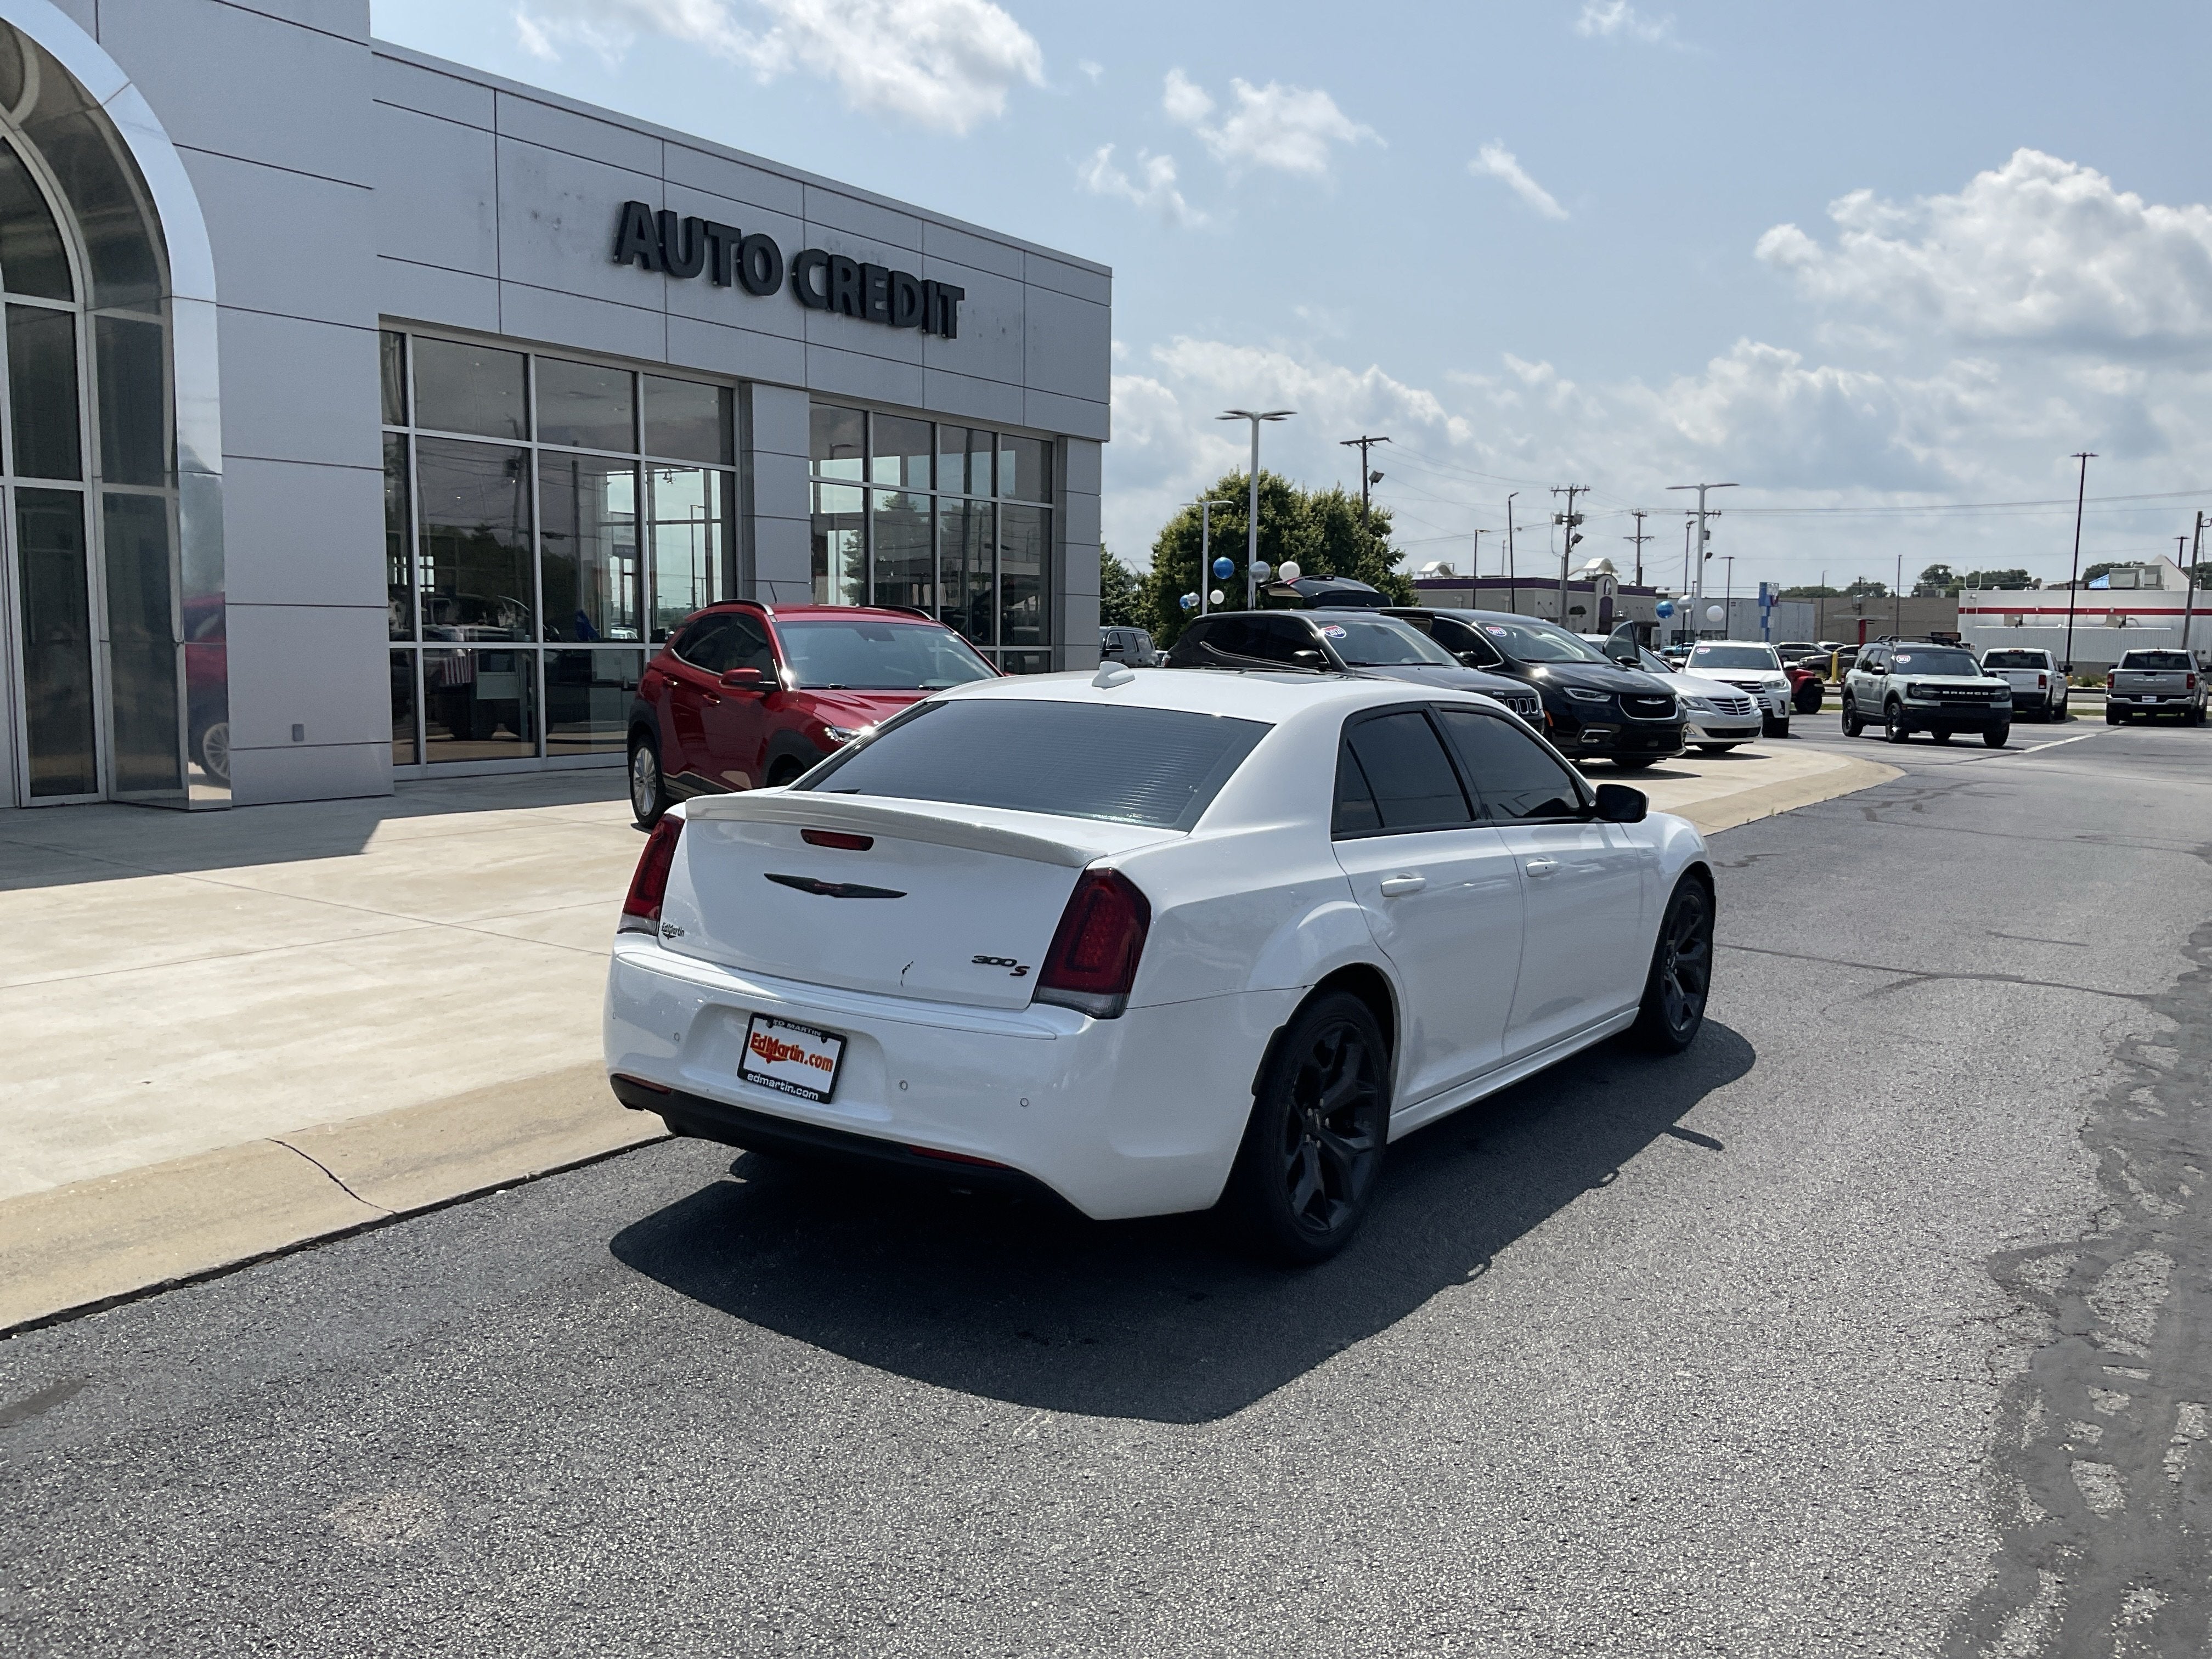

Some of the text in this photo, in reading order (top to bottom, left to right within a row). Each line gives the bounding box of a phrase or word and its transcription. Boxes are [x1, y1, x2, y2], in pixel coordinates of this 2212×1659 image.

[613, 200, 965, 339] AUTO CREDIT
[661, 922, 685, 937] EdMartin
[972, 955, 1030, 976] 300 S
[787, 1023, 821, 1036] MARTIN
[749, 1031, 834, 1072] EdMartin.com
[747, 1073, 819, 1101] edmartin.com
